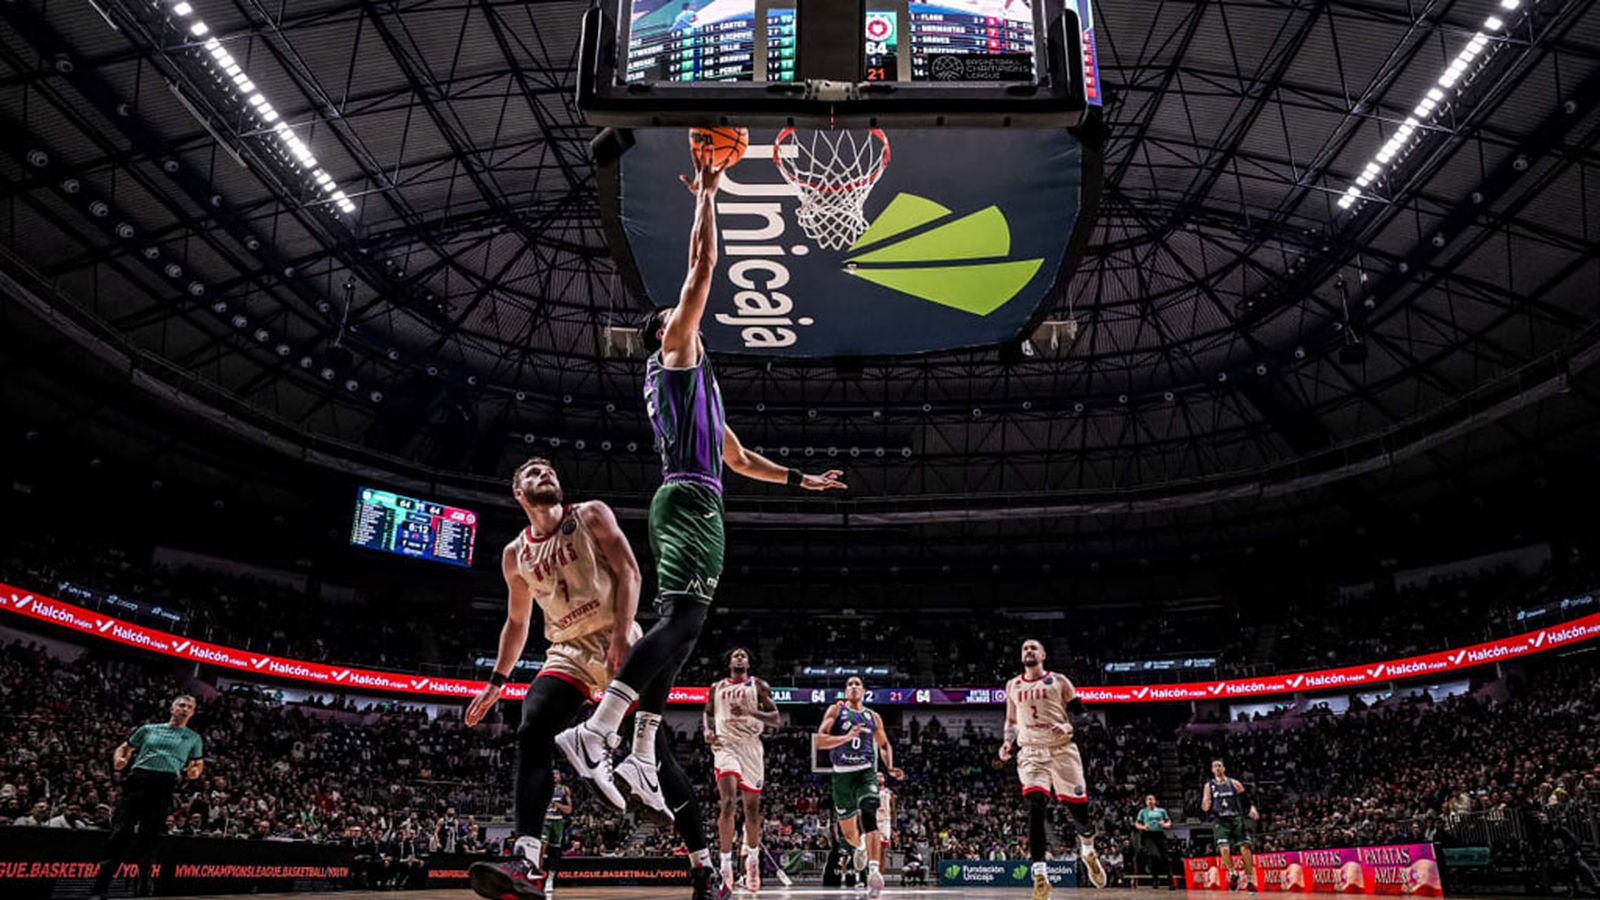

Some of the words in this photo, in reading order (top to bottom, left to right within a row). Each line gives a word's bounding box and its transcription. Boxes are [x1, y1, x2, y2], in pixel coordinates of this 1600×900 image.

[867, 67, 885, 80] 21
[966, 65, 1030, 73] CHAMPIONS
[715, 144, 815, 348] Unicaja
[31, 600, 74, 623] Halcón
[112, 624, 151, 645] Halcón
[1547, 625, 1587, 644] Halcón
[189, 645, 229, 663] Halcón
[1467, 645, 1508, 662] Halcón
[269, 661, 309, 676] Halcón
[1386, 661, 1427, 675] Halcón
[349, 672, 389, 687] Halcón
[1305, 673, 1345, 686] Halcón
[429, 681, 467, 693] Halcón
[1149, 688, 1187, 698] Halcón
[1226, 683, 1265, 694] Halcón
[811, 690, 826, 703] 64
[889, 691, 902, 702] 21
[916, 690, 931, 703] 64
[1030, 705, 1039, 719] 2
[851, 736, 861, 750] 0
[1304, 851, 1341, 867] PATATAS
[1363, 847, 1411, 866] PATATAS
[962, 864, 1005, 875] Fundación
[962, 873, 995, 883] Unicaja
